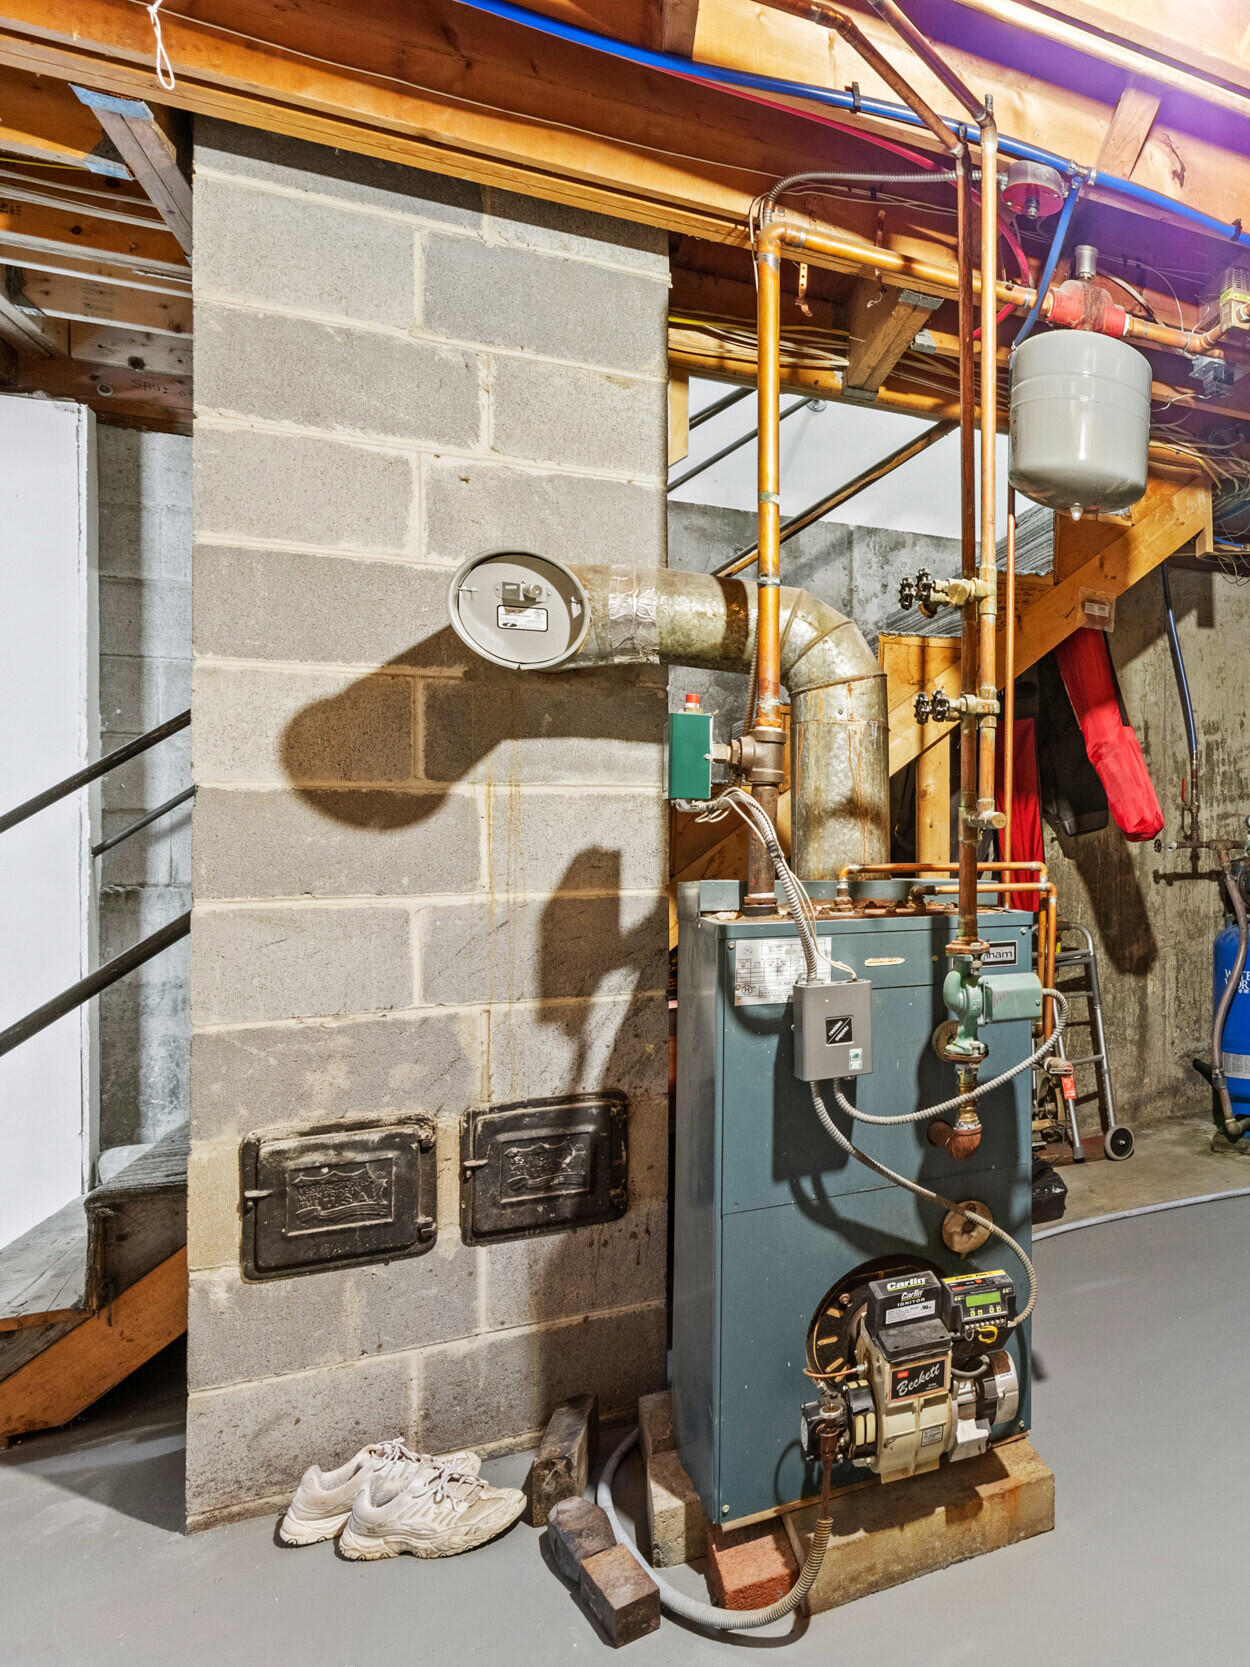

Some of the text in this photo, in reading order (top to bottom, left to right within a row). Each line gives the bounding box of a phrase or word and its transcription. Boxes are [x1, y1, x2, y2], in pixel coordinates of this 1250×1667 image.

[886, 1277, 927, 1290] Carlin
[900, 1289, 924, 1300] Carlin
[896, 1363, 941, 1397] Beckett
